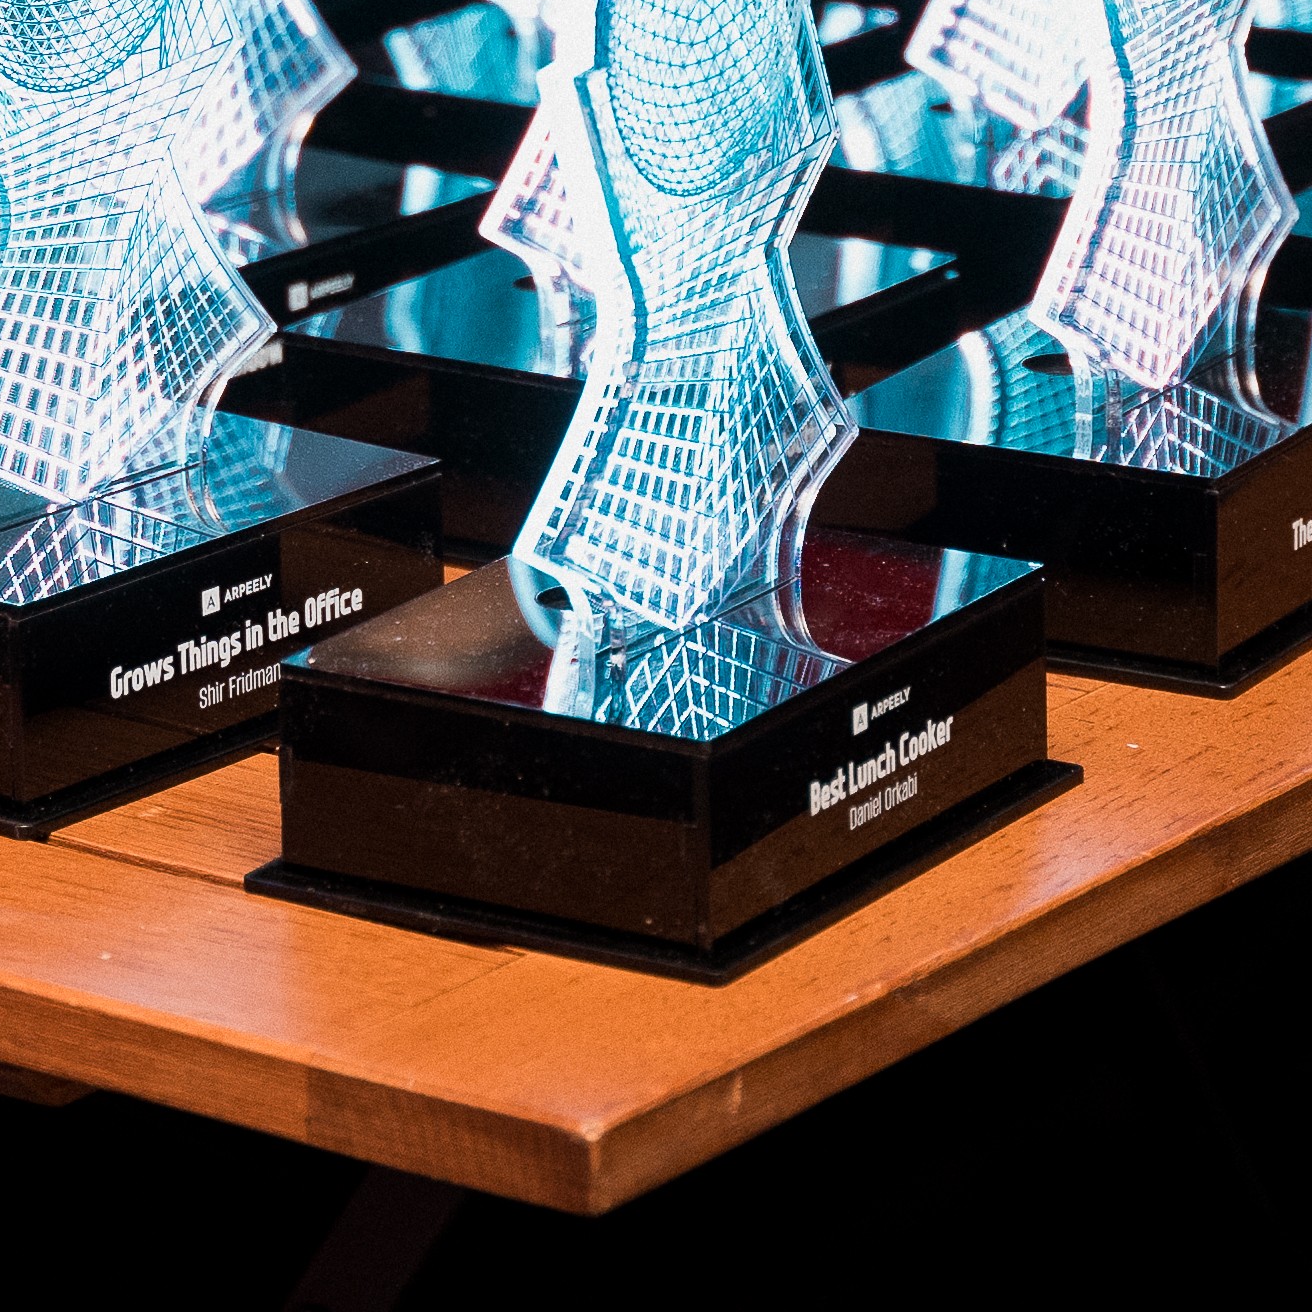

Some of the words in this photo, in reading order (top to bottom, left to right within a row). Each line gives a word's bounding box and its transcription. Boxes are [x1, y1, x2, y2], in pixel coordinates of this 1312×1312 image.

[224, 573, 273, 603] ARPEELY
[110, 654, 174, 700] Grows
[177, 637, 241, 676] Things
[245, 620, 263, 651] in
[268, 609, 300, 642] the
[304, 588, 363, 628] Office
[199, 682, 224, 709] Shir
[228, 662, 281, 699] Fridman
[871, 686, 911, 720] ARPEELY
[810, 767, 846, 816] Best
[848, 742, 896, 795] Lunch
[899, 716, 954, 767] Cooker
[850, 792, 882, 831] Daniel
[884, 772, 918, 811] Orkabi
